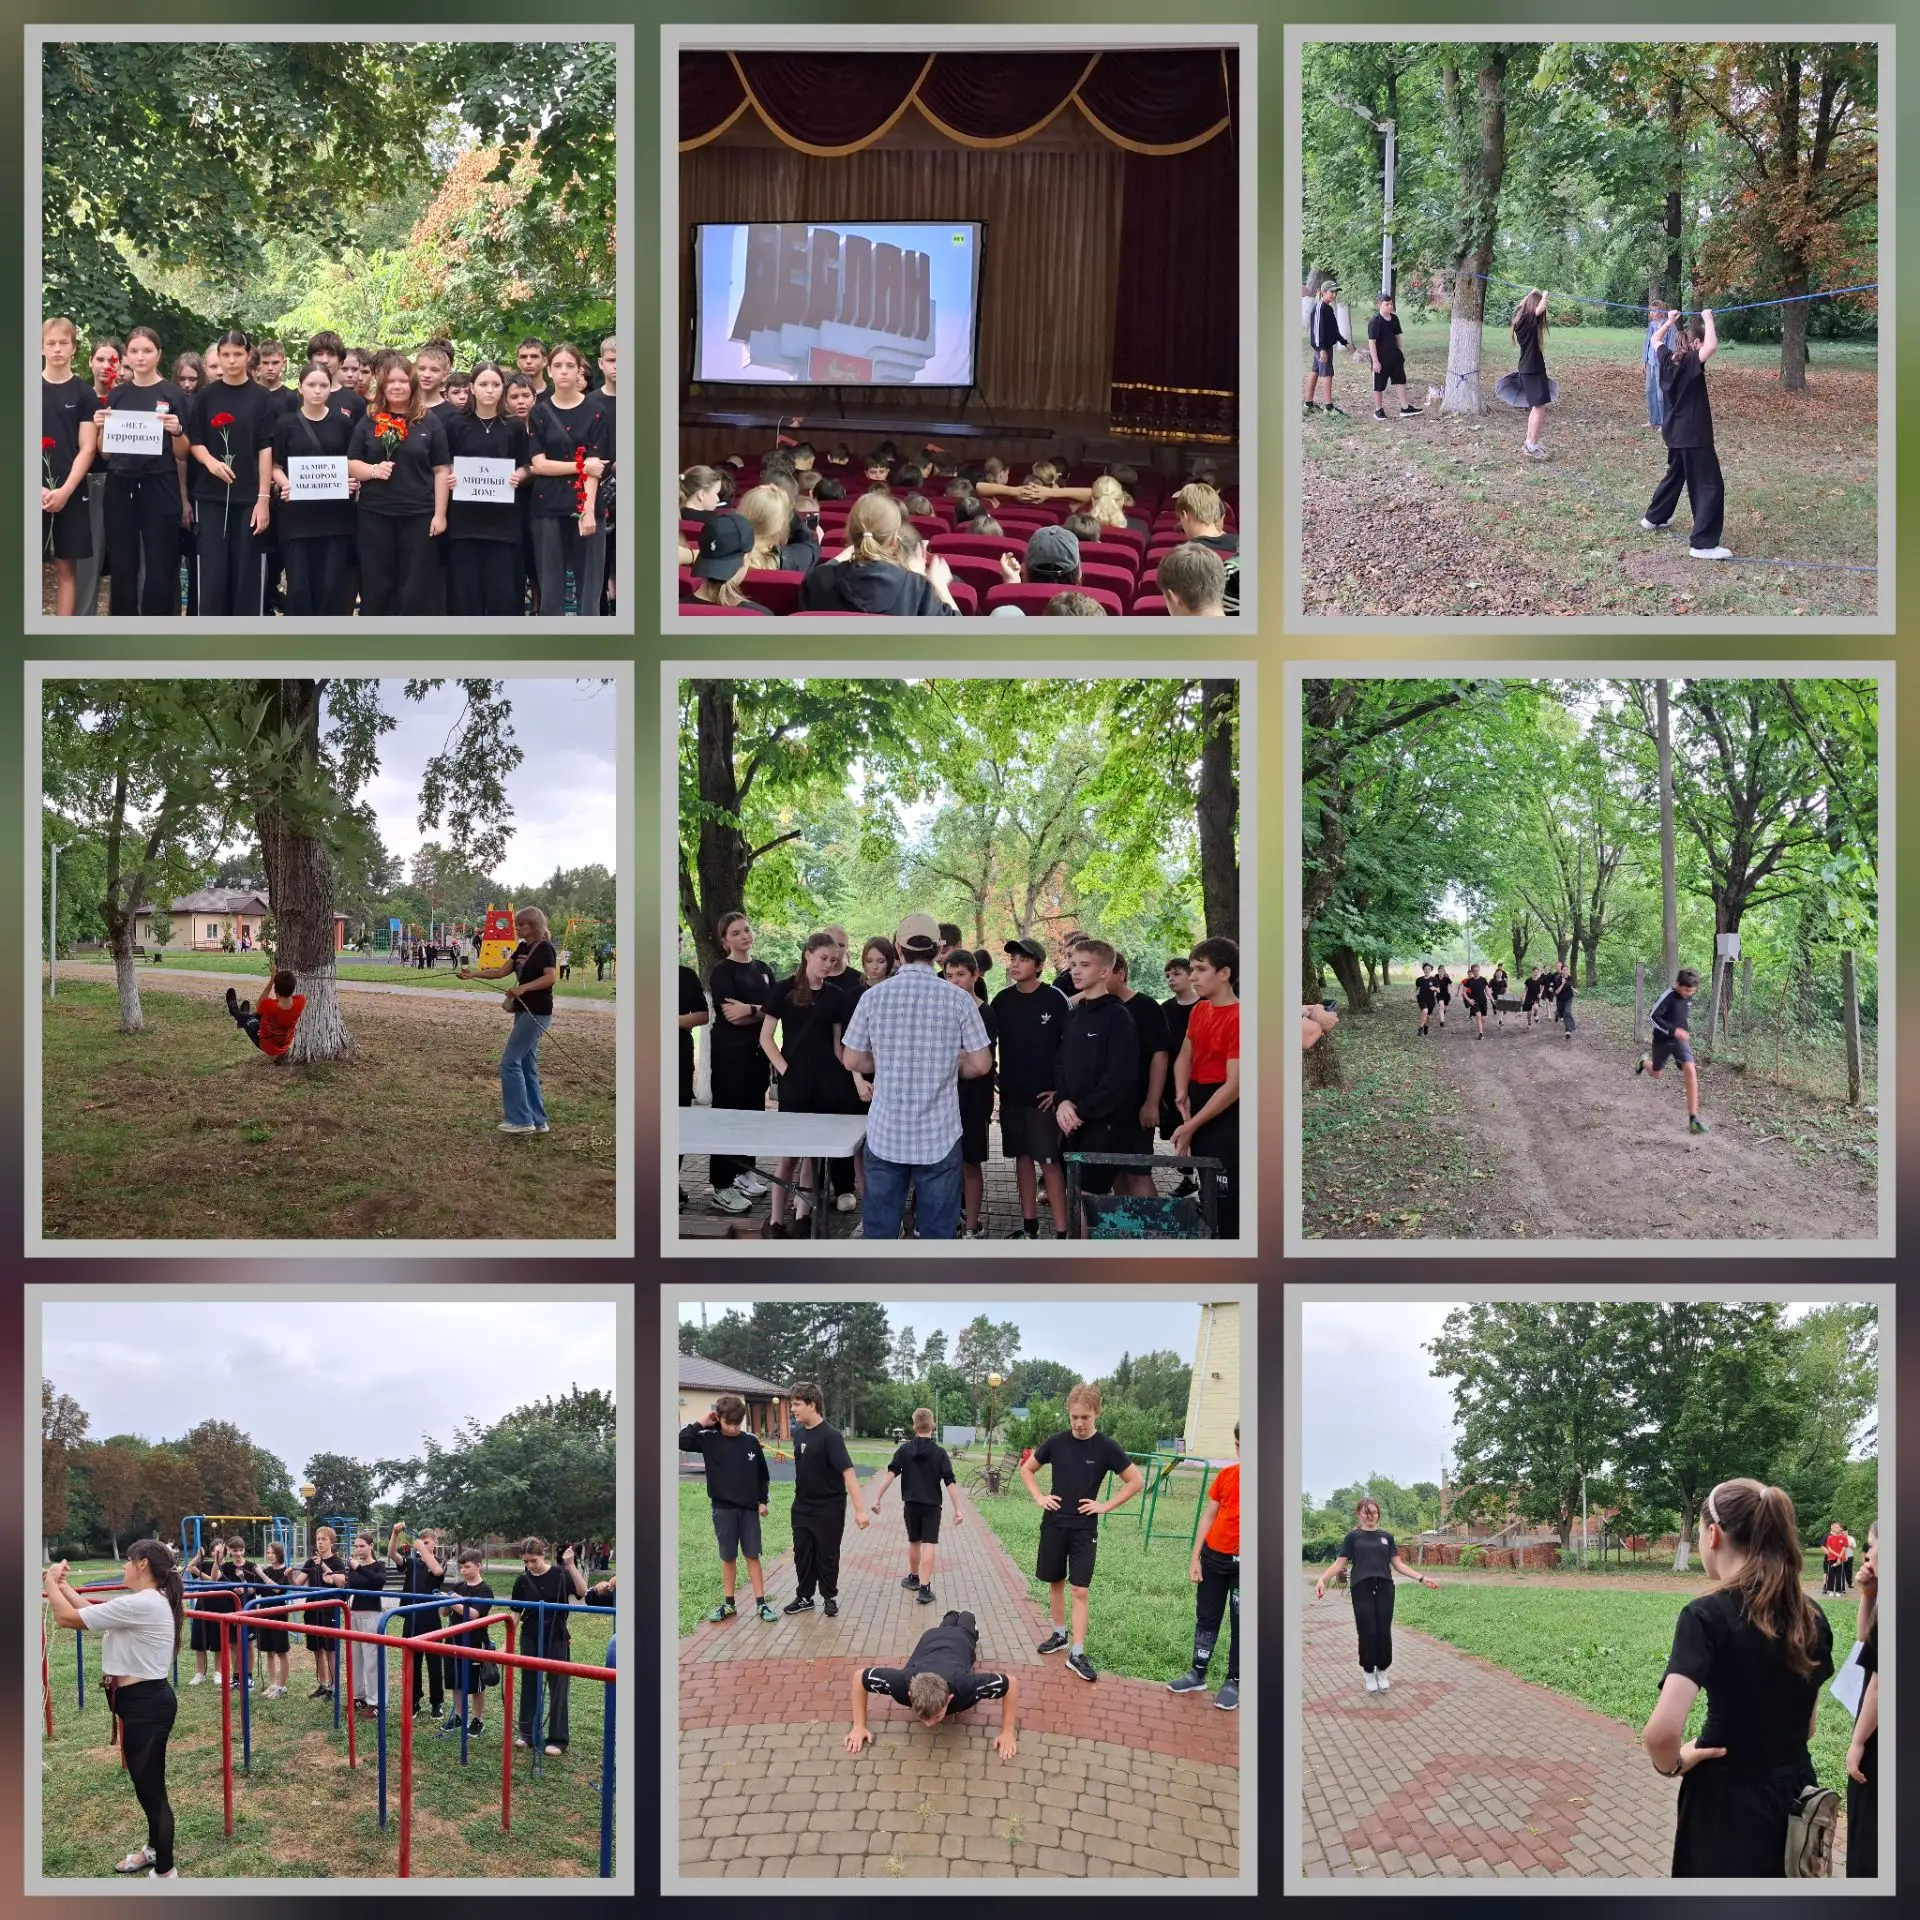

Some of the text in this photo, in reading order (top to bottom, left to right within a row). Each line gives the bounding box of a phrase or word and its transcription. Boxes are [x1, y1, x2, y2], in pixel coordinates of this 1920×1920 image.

[107, 433, 160, 444] терроризму
[479, 465, 489, 473] ЗА
[463, 476, 505, 486] МИРНЫЙ
[471, 488, 496, 497] ДОМ!
